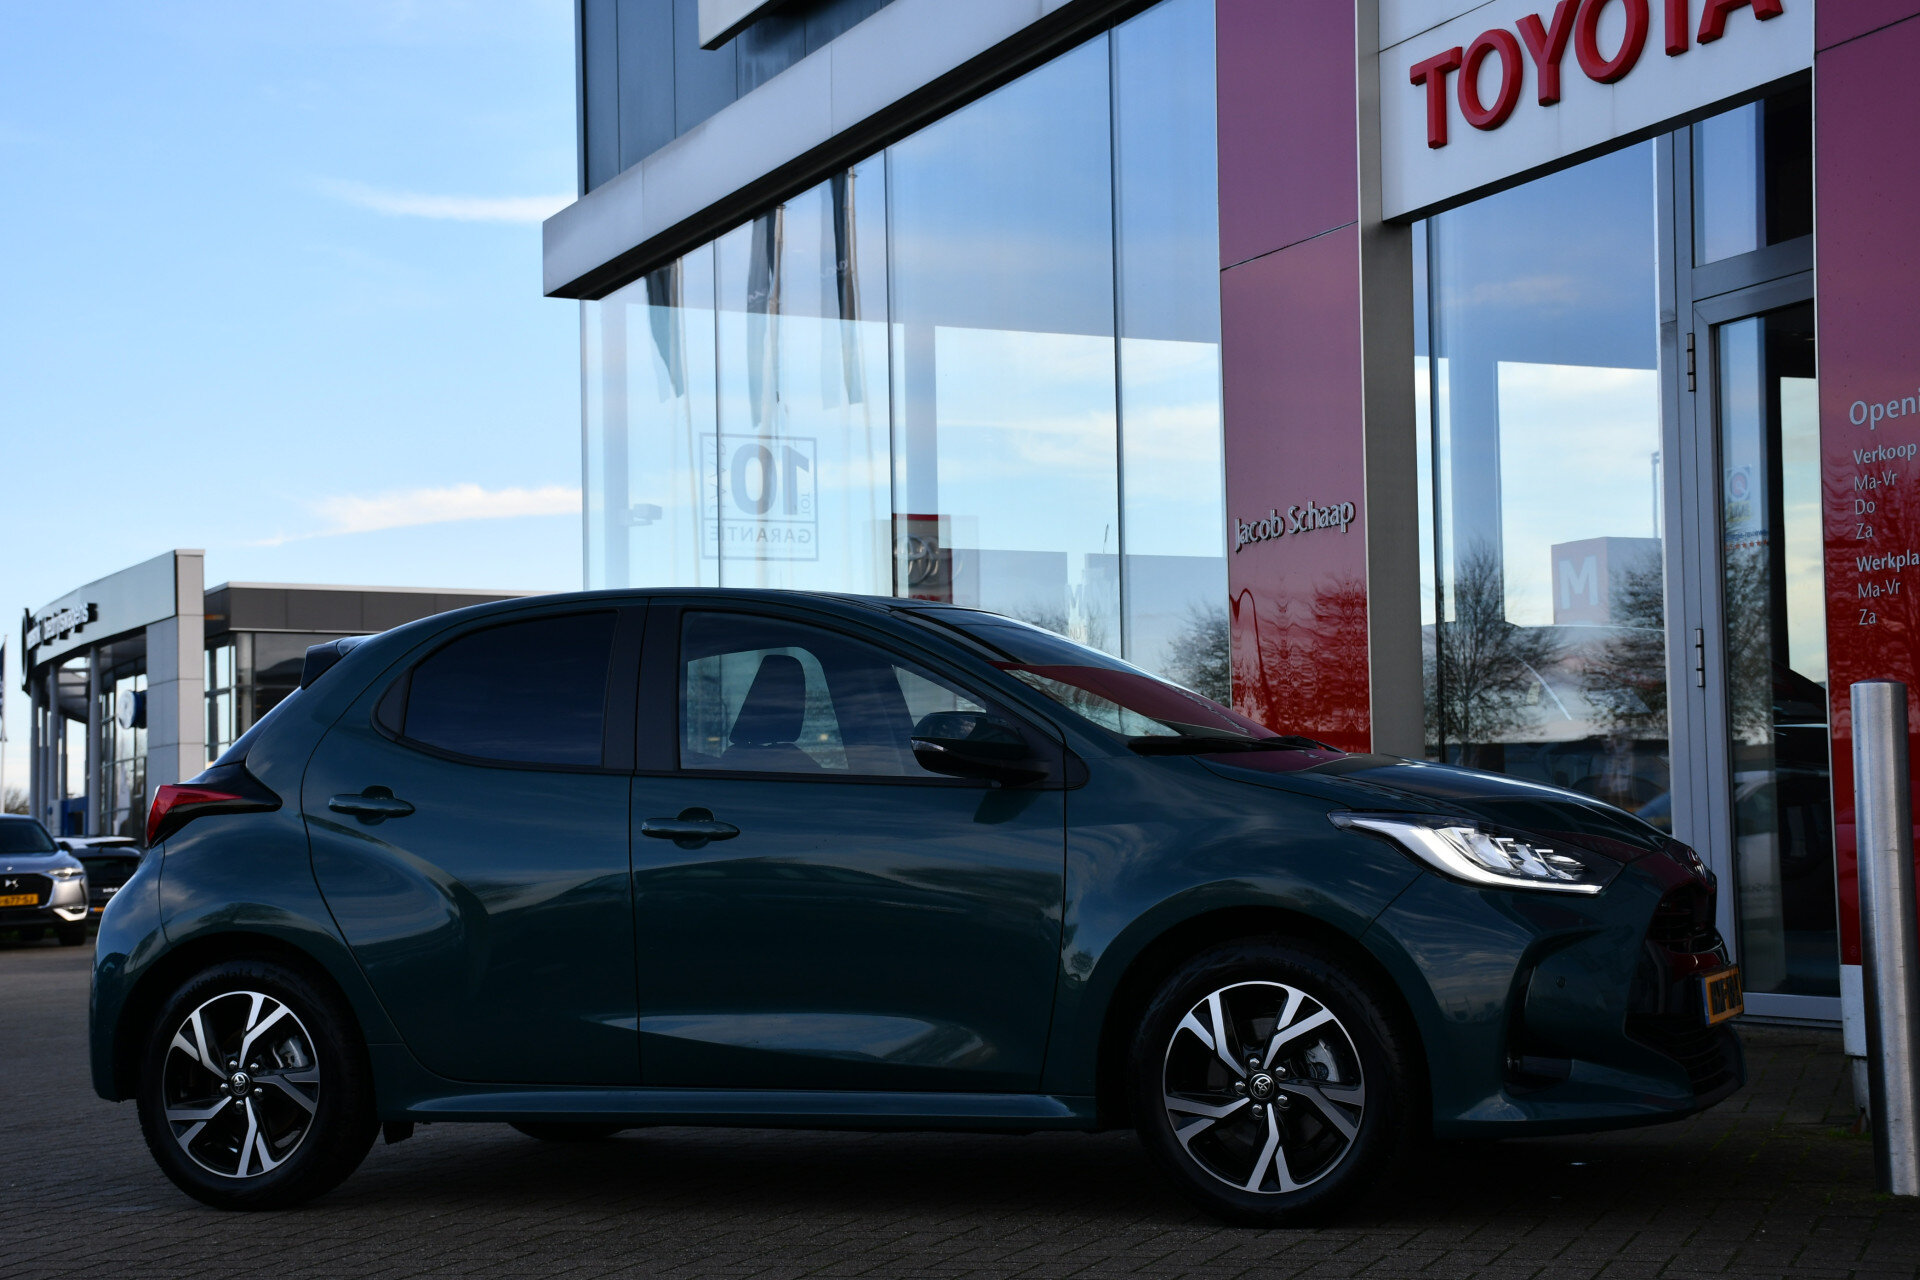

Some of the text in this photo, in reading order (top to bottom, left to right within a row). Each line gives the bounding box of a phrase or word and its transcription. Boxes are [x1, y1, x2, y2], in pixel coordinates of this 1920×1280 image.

[1853, 443, 1917, 465] Verkoop
[1854, 469, 1897, 491] Ma-Vr
[1855, 498, 1876, 515] Do
[1235, 501, 1356, 553] Jacob Schaap
[1856, 523, 1873, 540] Za
[1856, 549, 1920, 573] Werkpla
[1857, 578, 1901, 599] Ma-Vr
[1859, 608, 1876, 626] Za
